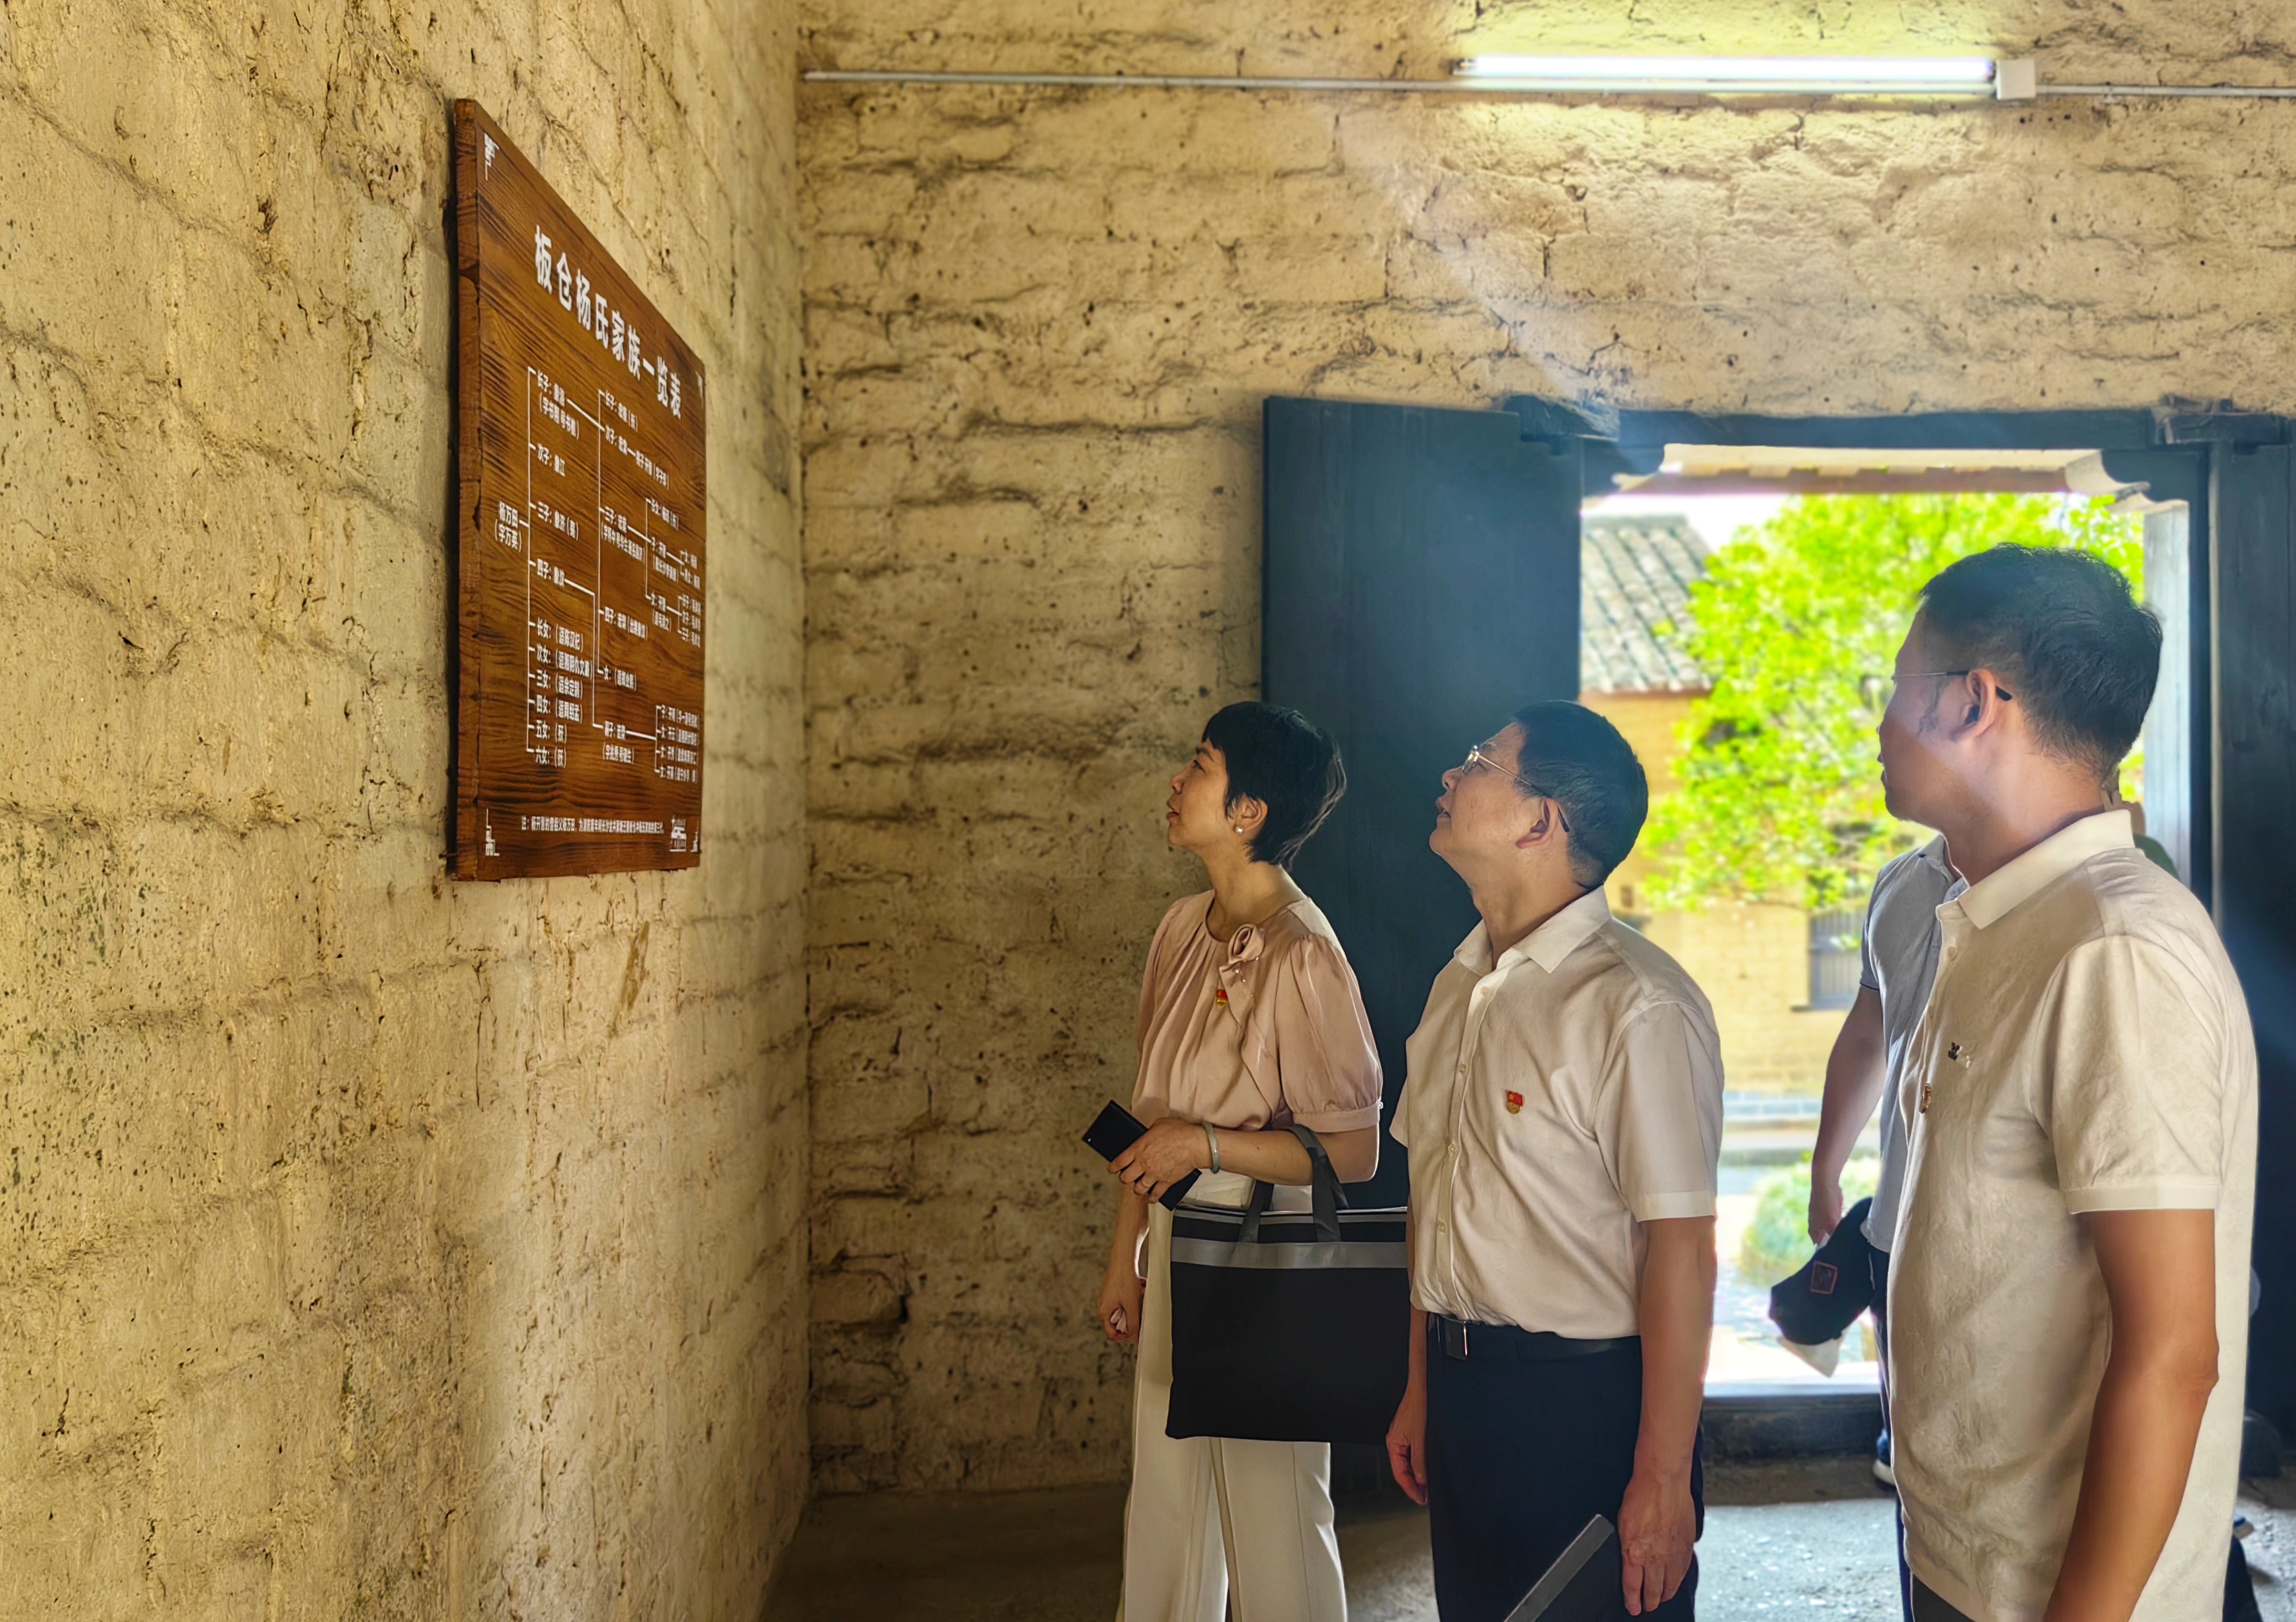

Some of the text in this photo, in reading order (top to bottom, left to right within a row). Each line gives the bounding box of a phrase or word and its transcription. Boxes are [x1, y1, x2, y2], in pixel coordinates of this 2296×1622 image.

[535, 225, 681, 419] 板仓杨氏家族一览表
[498, 501, 518, 528] 杨万田
